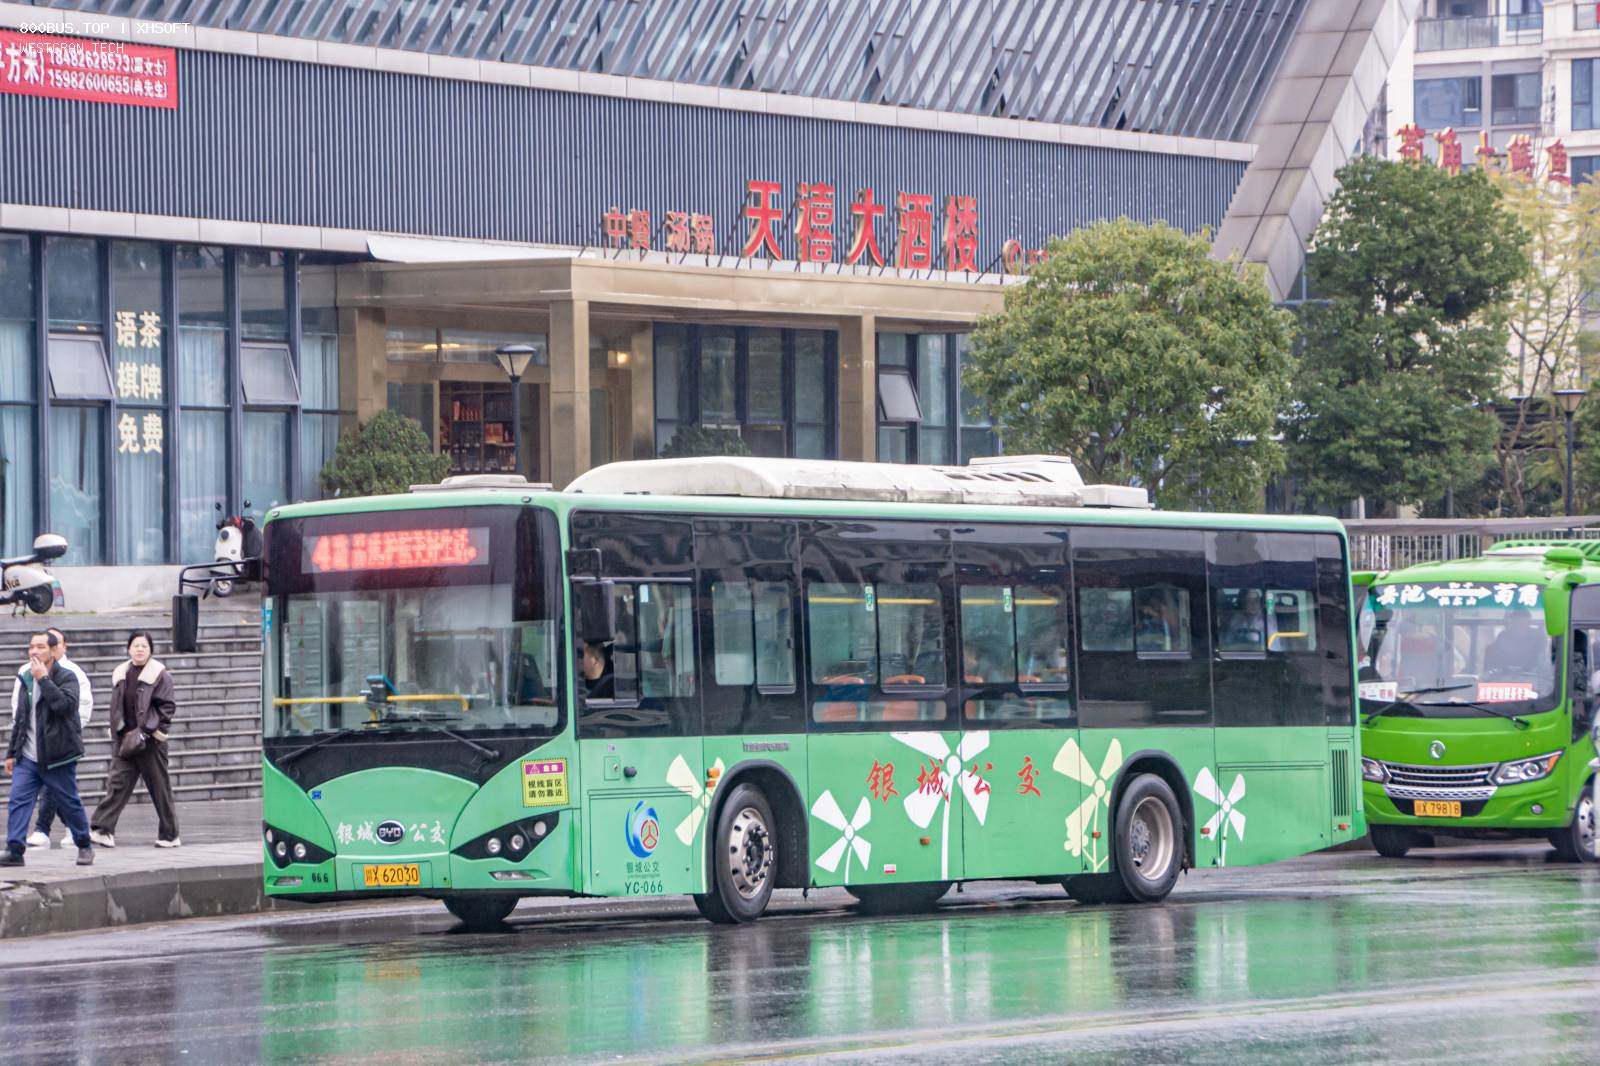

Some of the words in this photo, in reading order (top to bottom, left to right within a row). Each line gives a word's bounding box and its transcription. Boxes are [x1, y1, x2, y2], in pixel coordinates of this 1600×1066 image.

[743, 179, 978, 273] 天禧大酒楼
[116, 361, 162, 400] 棋牌
[118, 412, 163, 455] 免费
[865, 755, 1041, 803] 银城公交
[378, 827, 401, 838] BYD
[311, 872, 328, 883] 066
[624, 879, 663, 895] YC-066
